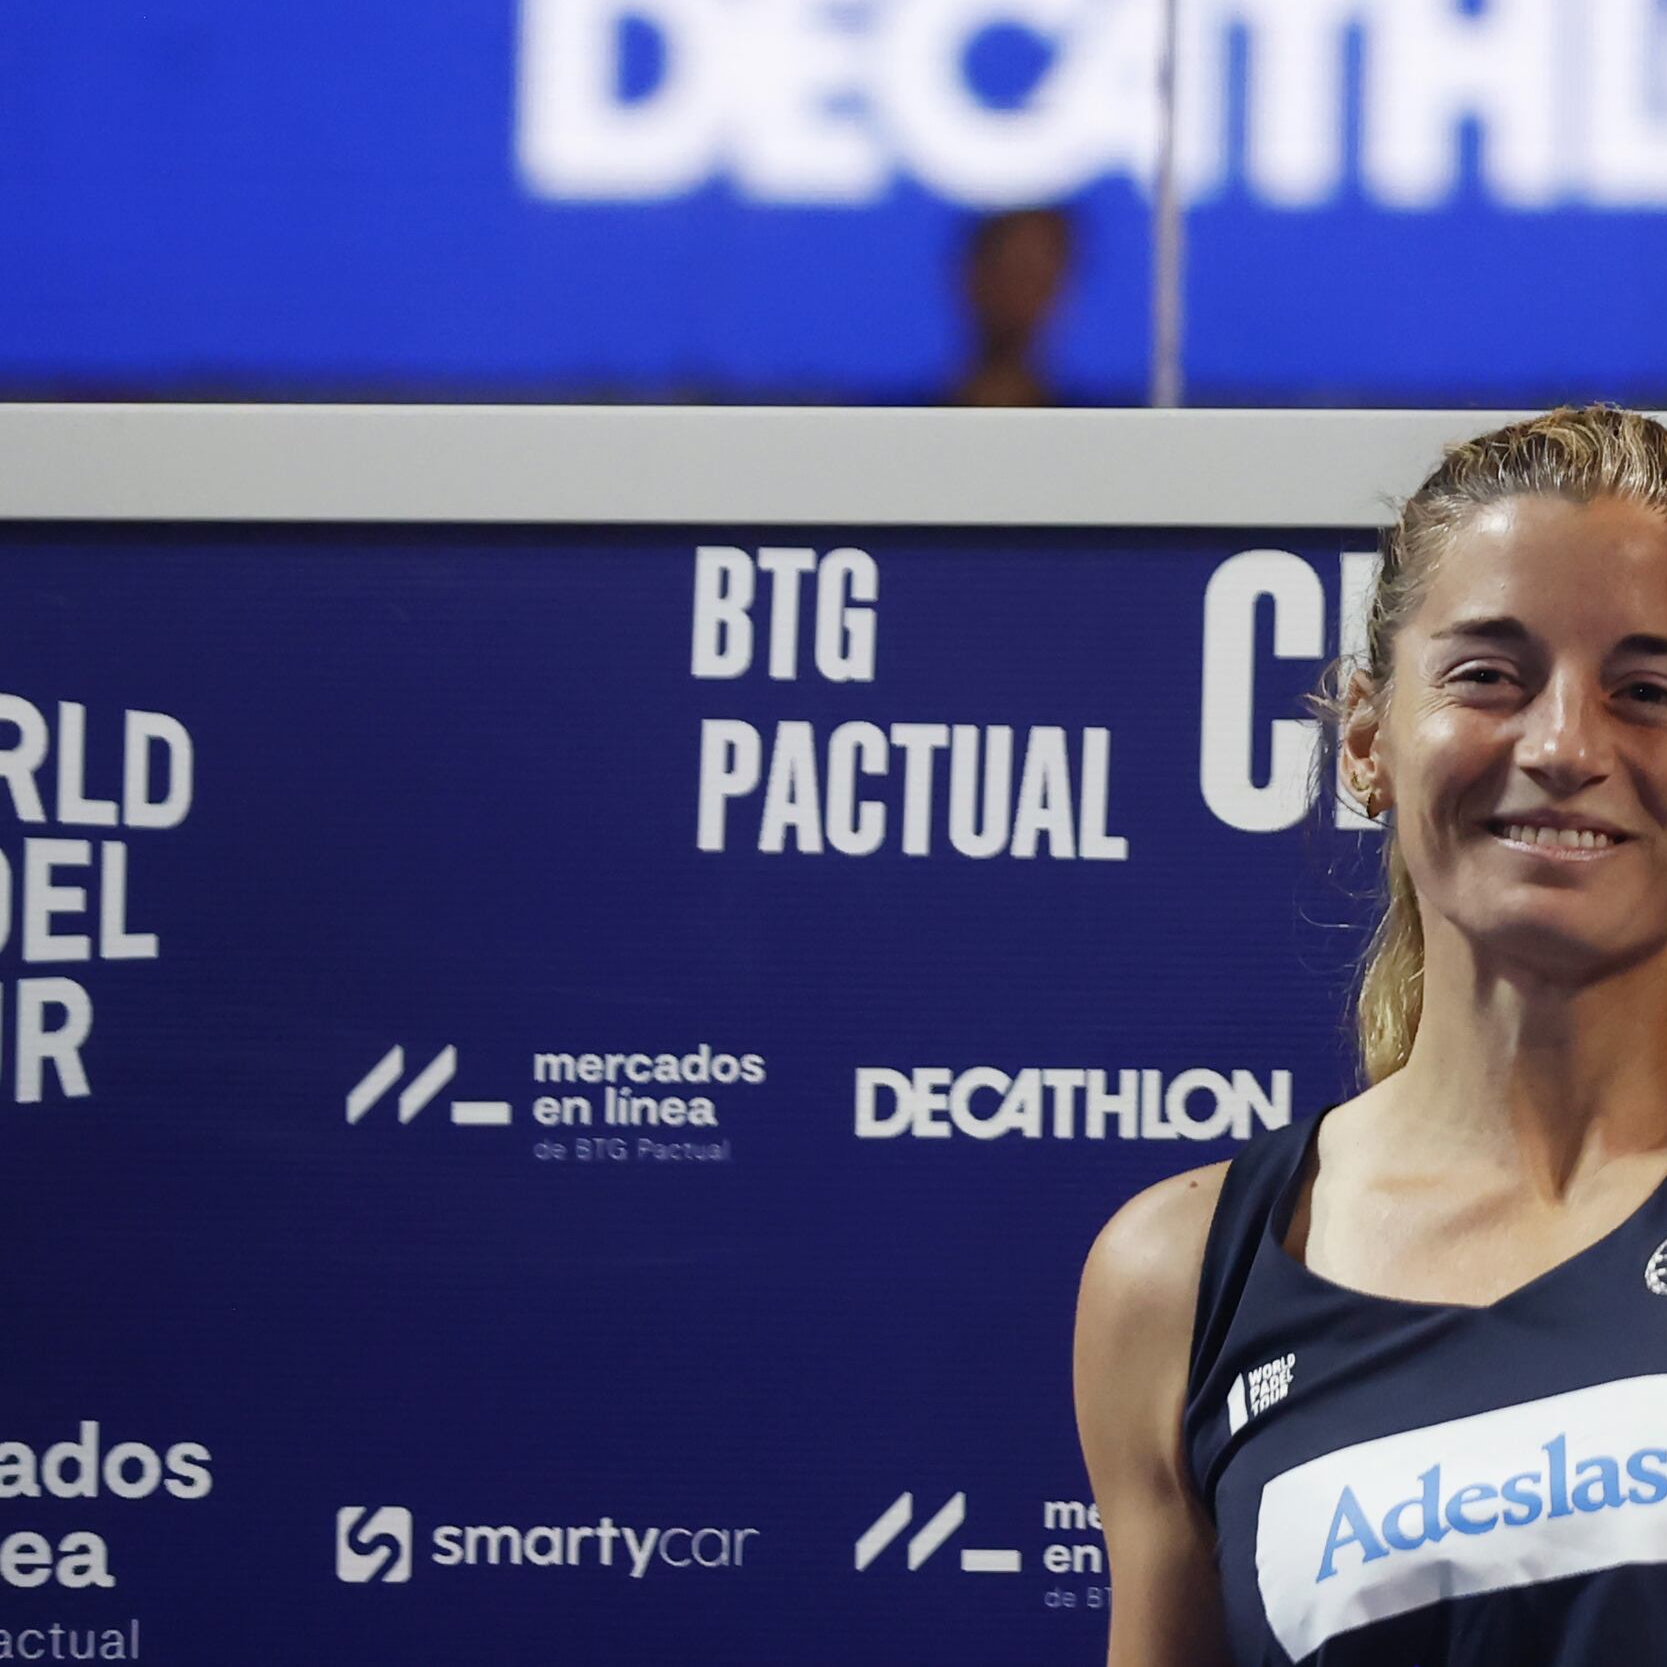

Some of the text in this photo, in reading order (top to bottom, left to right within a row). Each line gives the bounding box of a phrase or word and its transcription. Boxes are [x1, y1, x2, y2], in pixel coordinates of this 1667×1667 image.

[691, 545, 879, 682] BTG
[697, 718, 1129, 861] PACTUAL
[533, 1043, 767, 1083] mercados
[533, 1097, 592, 1126] en
[855, 1065, 1293, 1141] DECATHLON
[533, 1137, 731, 1161] de BTG Pactual
[1248, 1353, 1296, 1387] WORLD
[1250, 1368, 1294, 1405] PADEL
[1251, 1383, 1289, 1417] TOUR
[432, 1517, 760, 1578] smartycar
[1043, 1544, 1102, 1573] en
[1044, 1587, 1076, 1608] de
